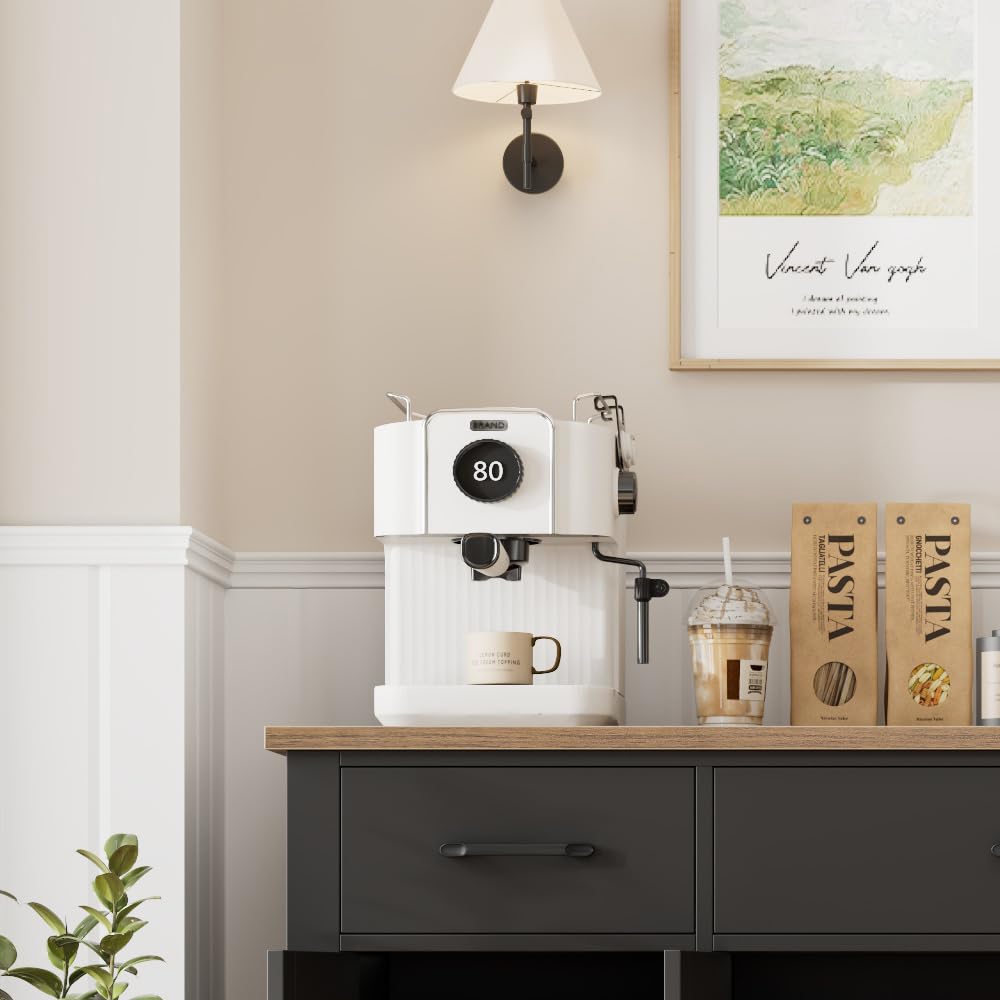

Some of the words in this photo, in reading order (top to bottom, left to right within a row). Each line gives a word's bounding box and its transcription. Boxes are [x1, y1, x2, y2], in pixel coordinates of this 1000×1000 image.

[764, 240, 834, 280] Vincent
[844, 240, 881, 280] Van
[472, 420, 505, 430] BRAND
[473, 460, 504, 482] 80
[827, 533, 856, 642] PASTA
[924, 533, 952, 644] PASTA
